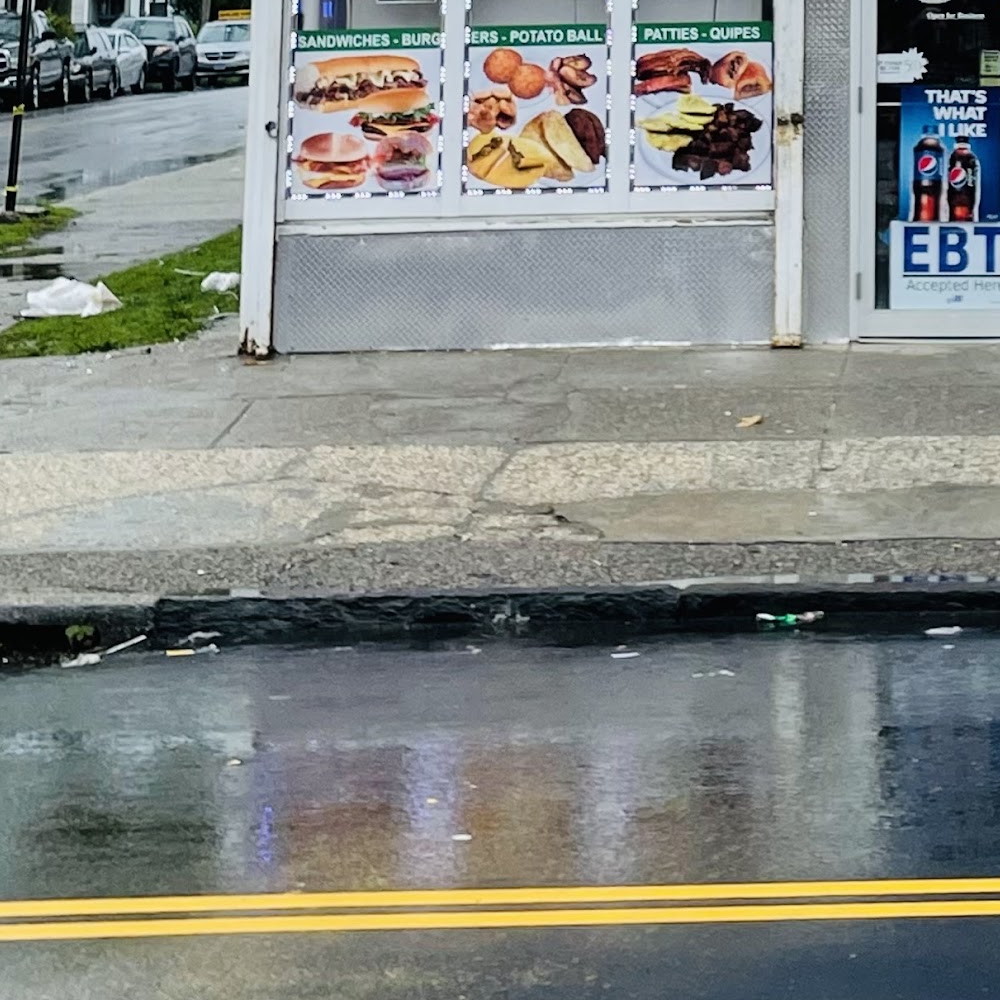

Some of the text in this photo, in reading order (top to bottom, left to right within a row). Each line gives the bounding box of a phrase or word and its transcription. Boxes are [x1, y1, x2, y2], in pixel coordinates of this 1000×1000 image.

[298, 33, 391, 49] SANDWICHES
[401, 32, 441, 47] BURG
[471, 30, 499, 44] ERS
[510, 29, 564, 43] POTATO
[567, 28, 604, 42] BALL
[644, 27, 699, 41] PATTIES
[709, 26, 761, 40] QUIPES
[924, 89, 988, 105] THAT'S
[933, 106, 988, 121] WHAT
[938, 122, 988, 138] I LIKE
[906, 279, 969, 293] Accepted
